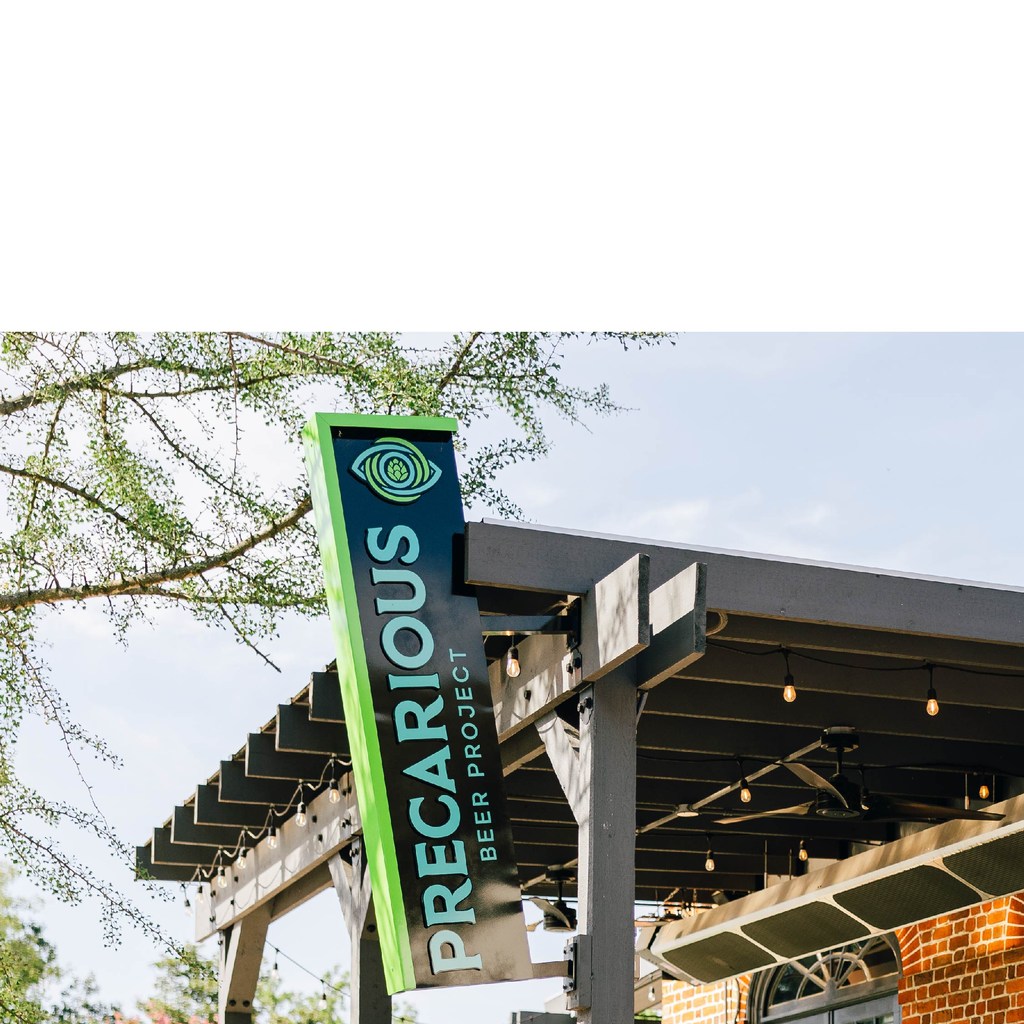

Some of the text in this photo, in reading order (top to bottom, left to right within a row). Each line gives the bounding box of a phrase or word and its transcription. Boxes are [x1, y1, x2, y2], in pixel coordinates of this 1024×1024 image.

[367, 524, 483, 975] PRECARIOUS
[448, 648, 498, 862] BEER PROJECT
